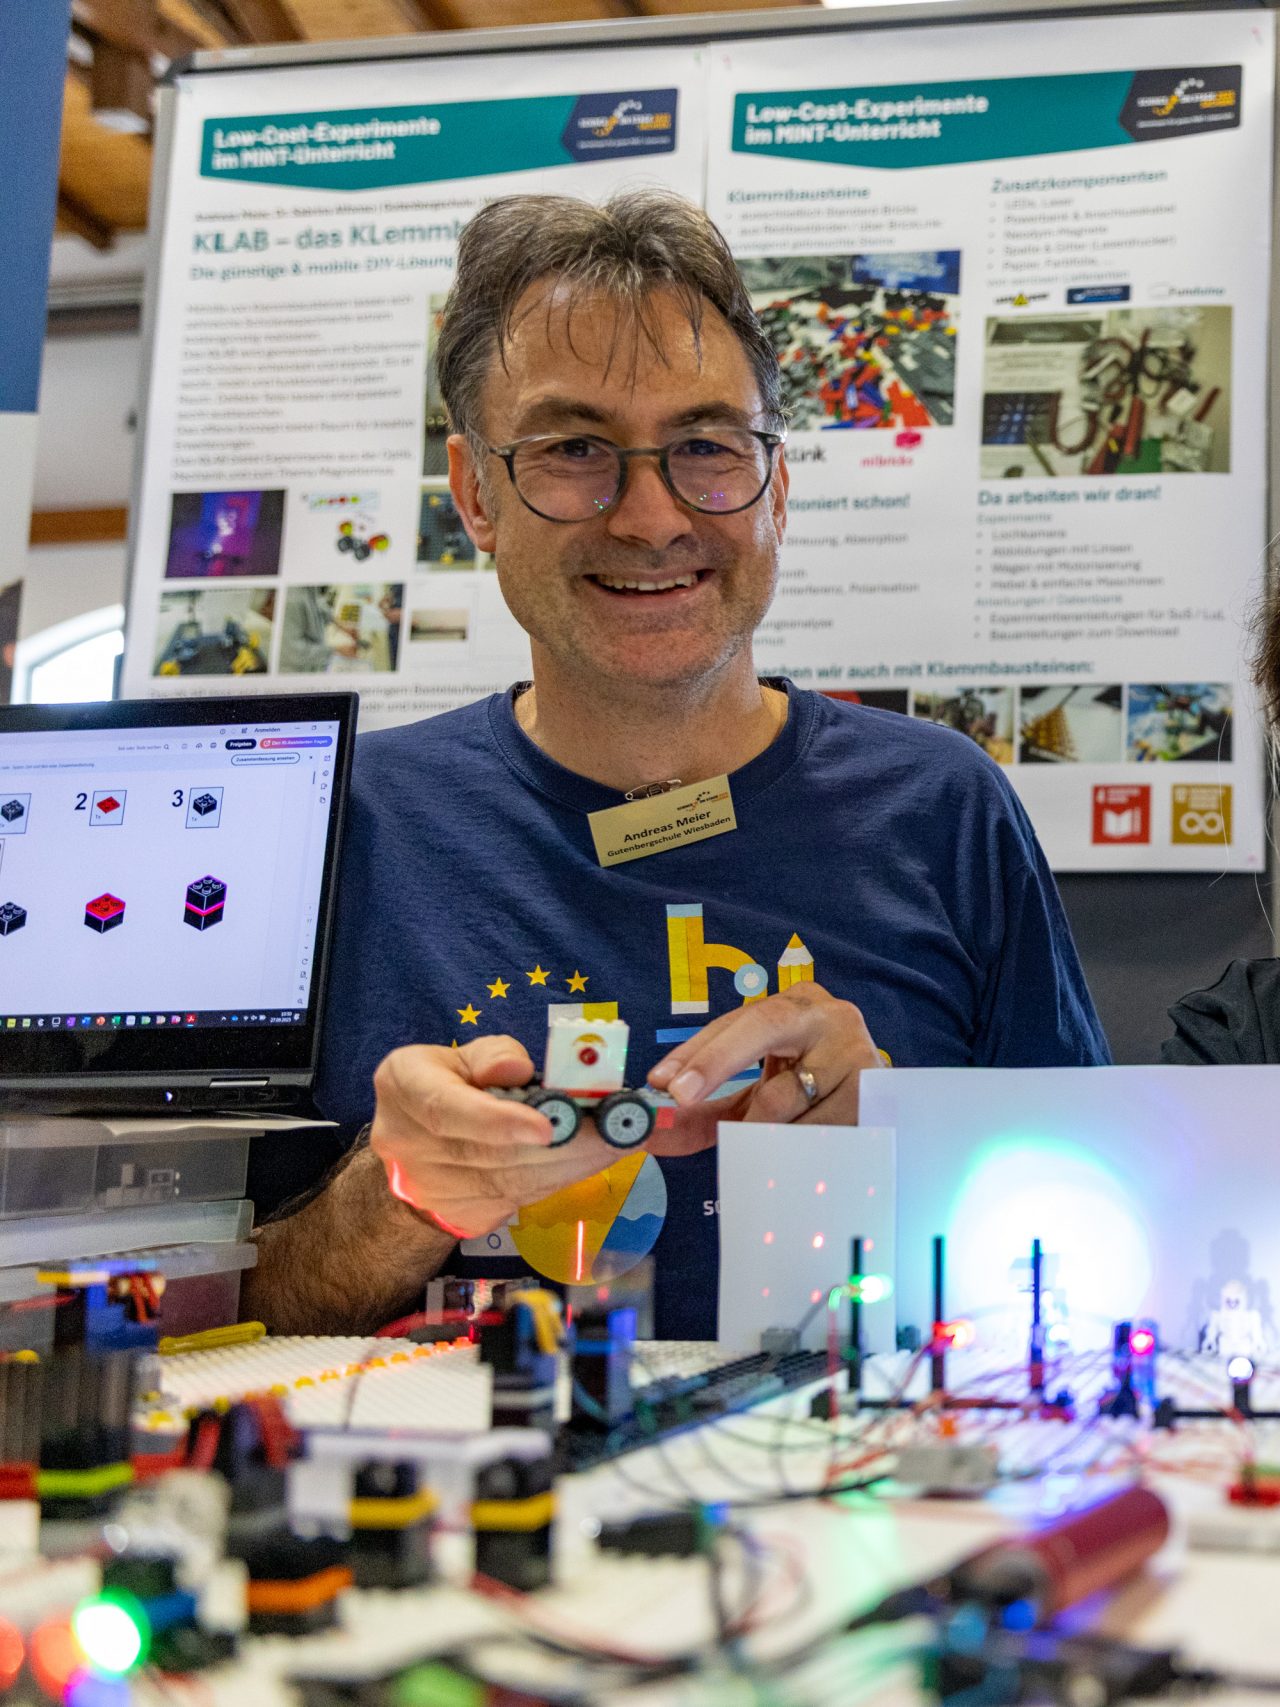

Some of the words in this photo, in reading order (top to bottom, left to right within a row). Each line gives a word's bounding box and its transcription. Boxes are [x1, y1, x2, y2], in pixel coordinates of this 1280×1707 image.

[747, 95, 989, 122] Low-Cost-Experimente
[213, 117, 441, 148] Low-Cost-Experimente
[744, 125, 773, 145] im
[774, 119, 942, 144] MINT-Unterricht
[211, 150, 239, 170] im
[240, 140, 397, 168] MINT-Unterricht
[991, 170, 1168, 194] Zusatzkomponenten
[728, 187, 870, 203] Klemmbausteine
[192, 227, 269, 253] KLAB
[295, 228, 343, 248] das
[190, 267, 216, 281] Die
[977, 490, 1001, 507] Da
[1004, 487, 1079, 506] arbeiten
[1083, 486, 1111, 503] wir
[1115, 484, 1162, 502] dran!
[817, 664, 843, 679] wir
[847, 662, 889, 677] auch
[894, 661, 922, 676] mit
[927, 659, 1095, 678] Klemmbausteinen:
[254, 726, 281, 734] Anmelden
[74, 792, 88, 811] 2
[172, 789, 184, 808] 3
[607, 832, 682, 858] Gutenbergschule
[683, 816, 731, 837] Wiesbaden
[623, 821, 673, 844] Andreas
[676, 809, 712, 828] Meier
